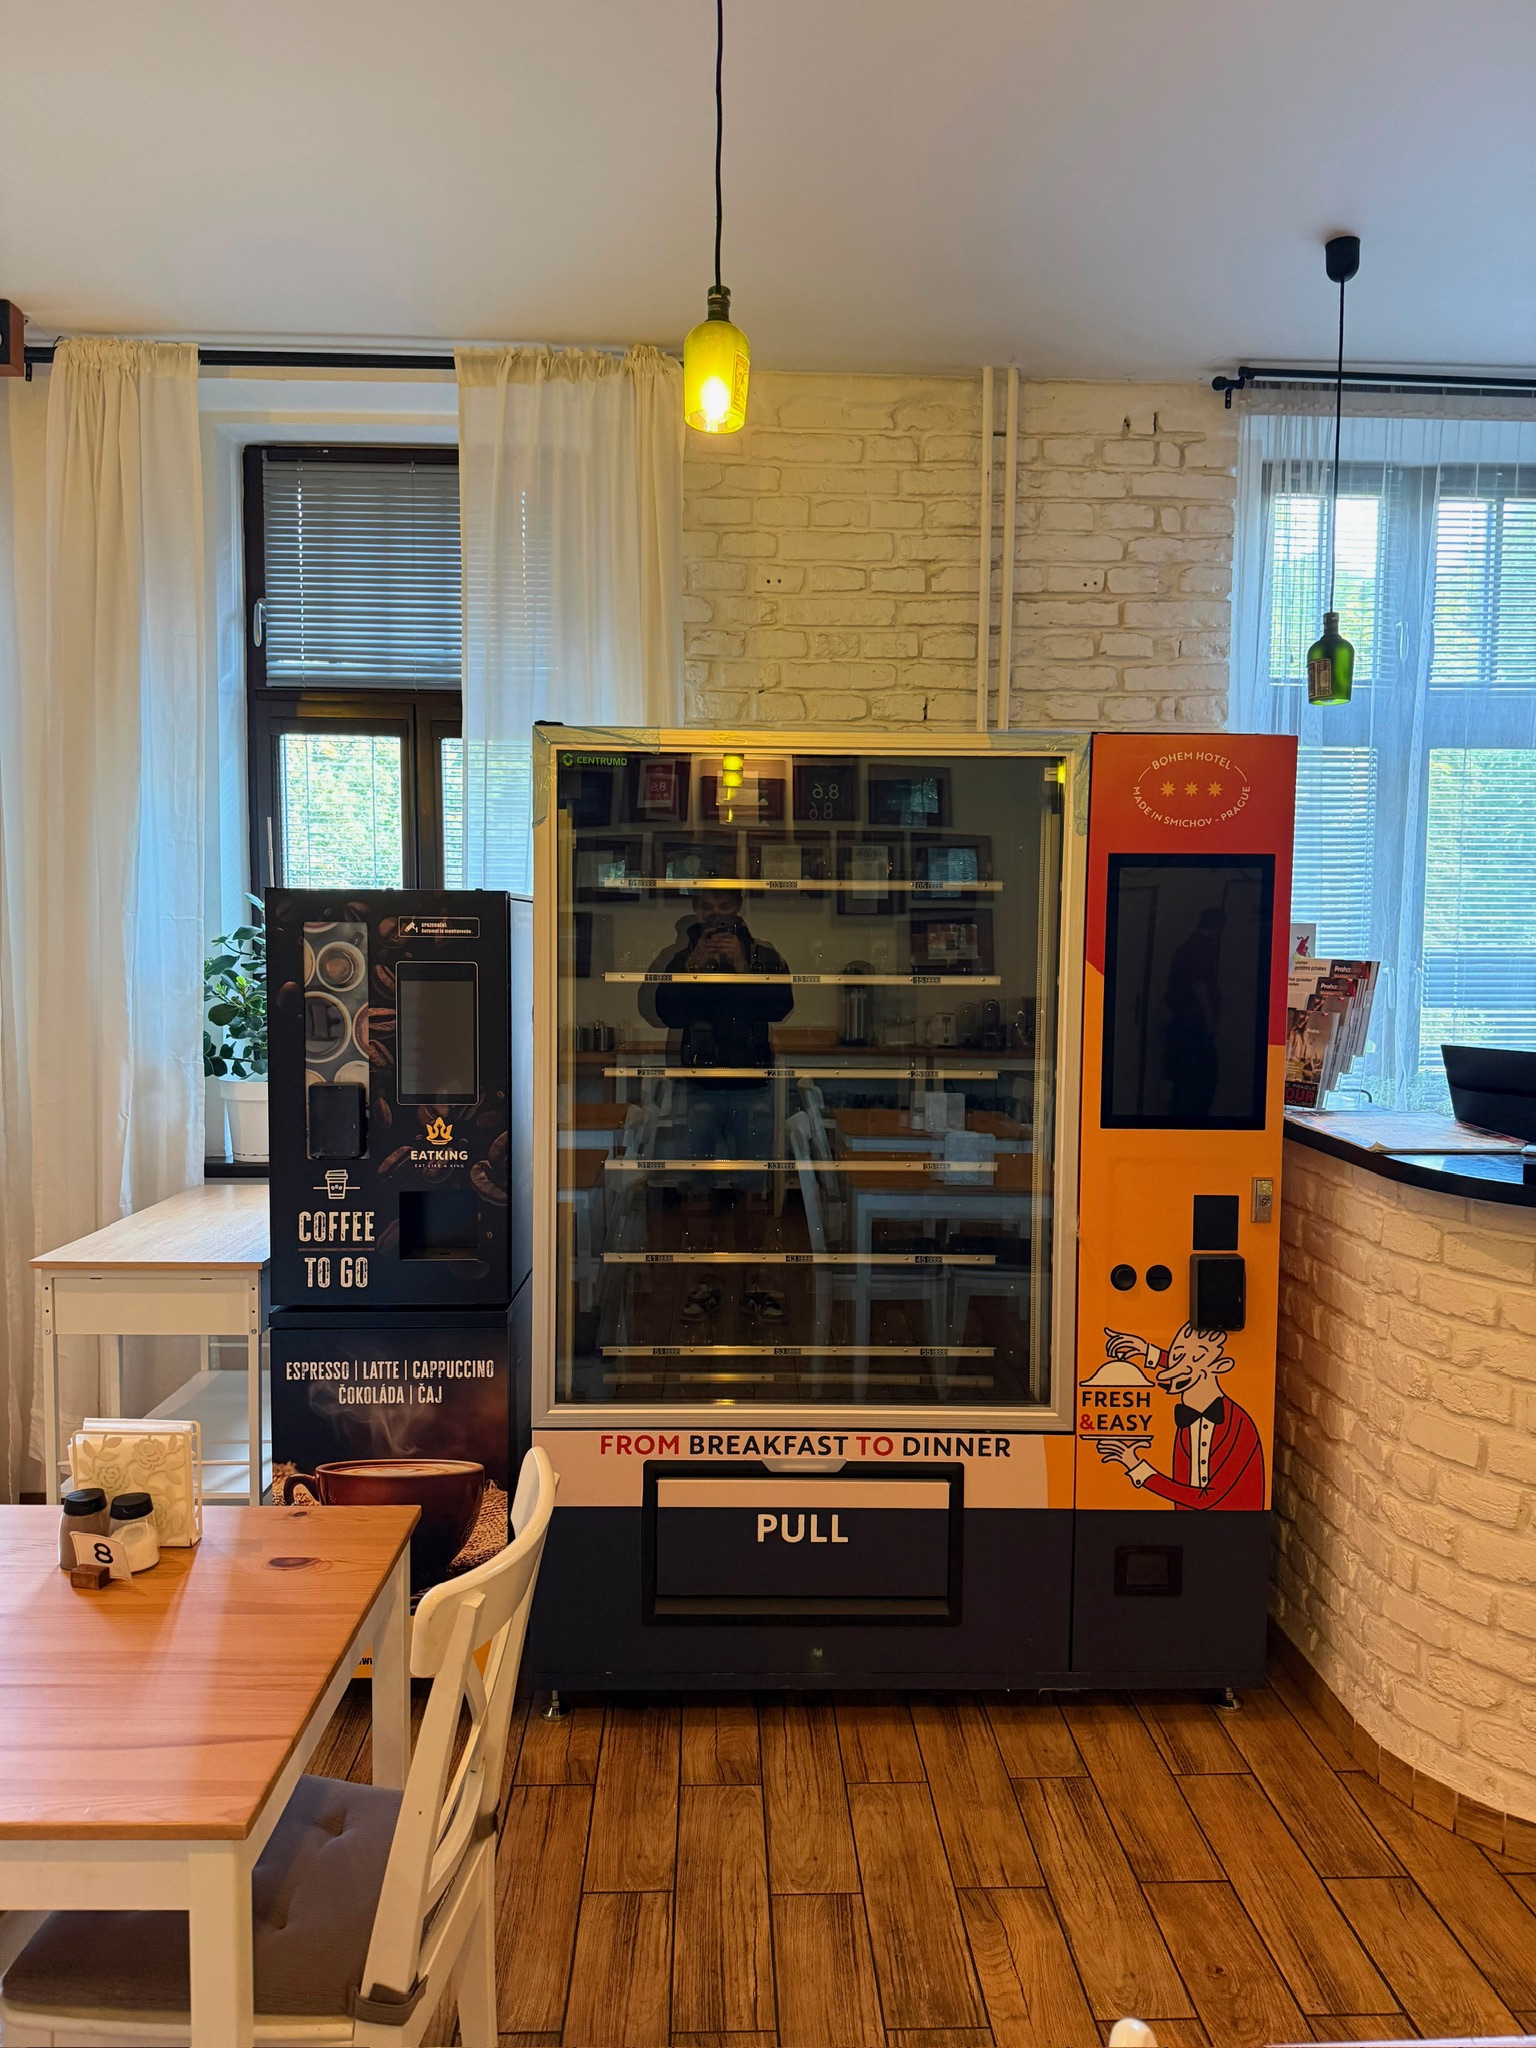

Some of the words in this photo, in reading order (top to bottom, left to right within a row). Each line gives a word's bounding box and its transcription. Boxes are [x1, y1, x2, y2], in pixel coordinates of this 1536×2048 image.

[576, 756, 628, 766] CENTRUMO
[1152, 752, 1193, 770] BOHEM
[1196, 752, 1231, 770] HOTEL
[1133, 786, 1152, 816] MADE
[1151, 811, 1163, 822] IN
[1164, 816, 1212, 828] SMICHOV
[1220, 786, 1251, 821] PRAGUE
[1286, 1088, 1315, 1102] OUR
[410, 1150, 469, 1161] EATKING
[298, 1211, 375, 1242] COFFEE
[304, 1257, 330, 1288] TO
[340, 1257, 368, 1288] GO
[286, 1361, 350, 1381] ESPRESSO
[363, 1360, 400, 1380] LATTE
[412, 1359, 495, 1380] CAPPUCCINO
[338, 1383, 405, 1405] ČOKOLÁDA
[417, 1383, 443, 1404] ČAJ
[1082, 1390, 1151, 1408] FRESH
[1080, 1414, 1153, 1432] &EASY
[600, 1435, 680, 1455] FROM
[689, 1435, 849, 1456] BREAKFAST
[856, 1436, 894, 1456] TO
[903, 1436, 1011, 1458] DINNER
[757, 1514, 849, 1543] PULL
[94, 1542, 114, 1564] 8
